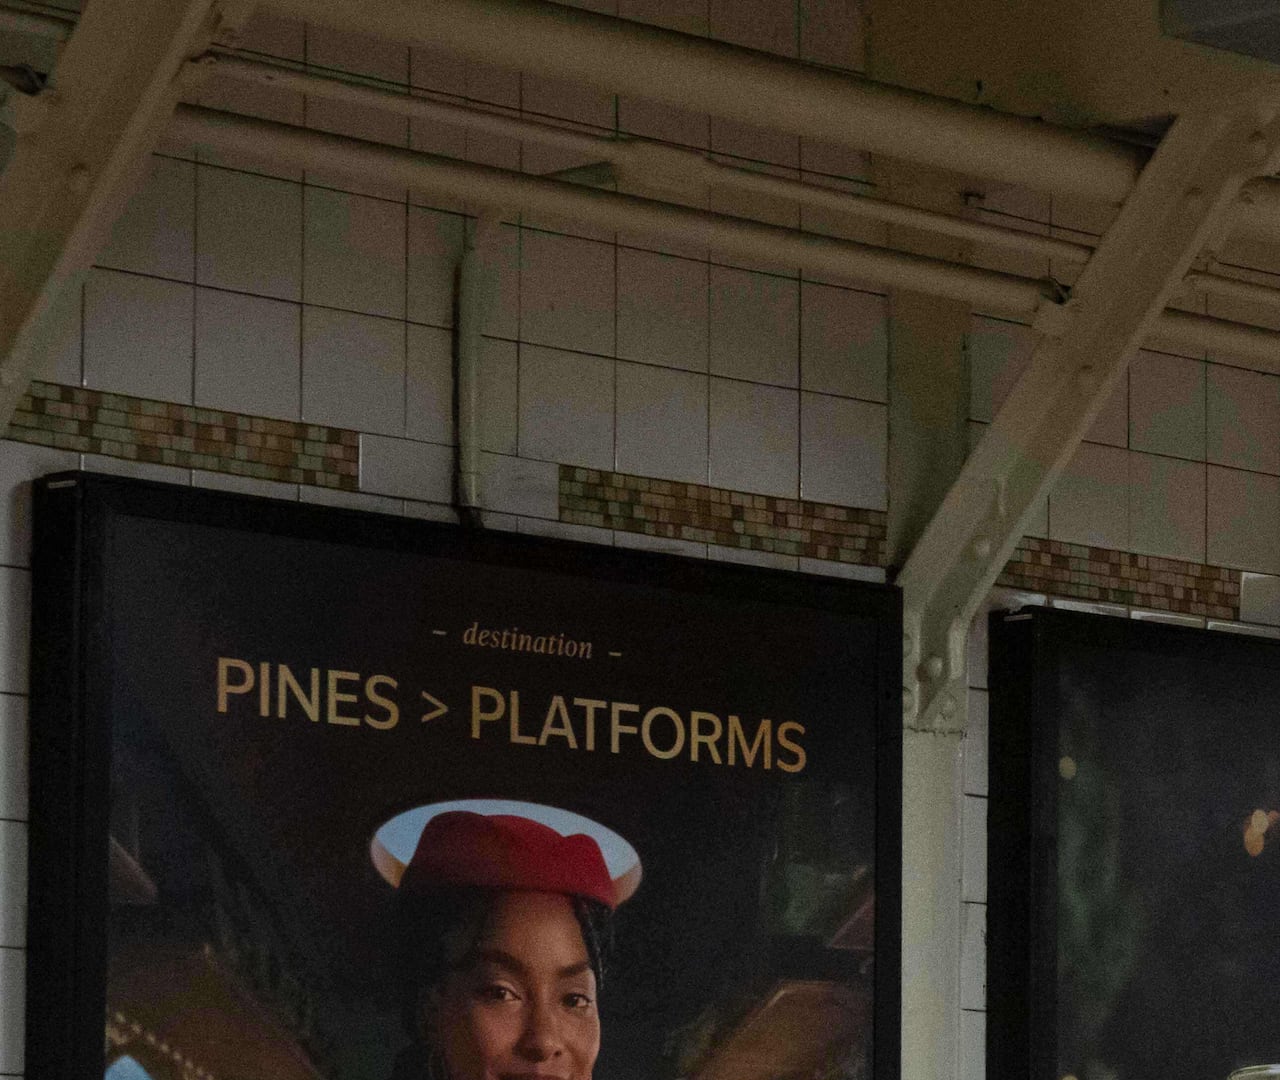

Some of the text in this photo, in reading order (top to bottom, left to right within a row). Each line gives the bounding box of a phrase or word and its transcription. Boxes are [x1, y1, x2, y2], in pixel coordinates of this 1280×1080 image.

[463, 622, 593, 659] destination
[216, 656, 400, 731] PINES
[471, 685, 807, 774] PLATFORMS
